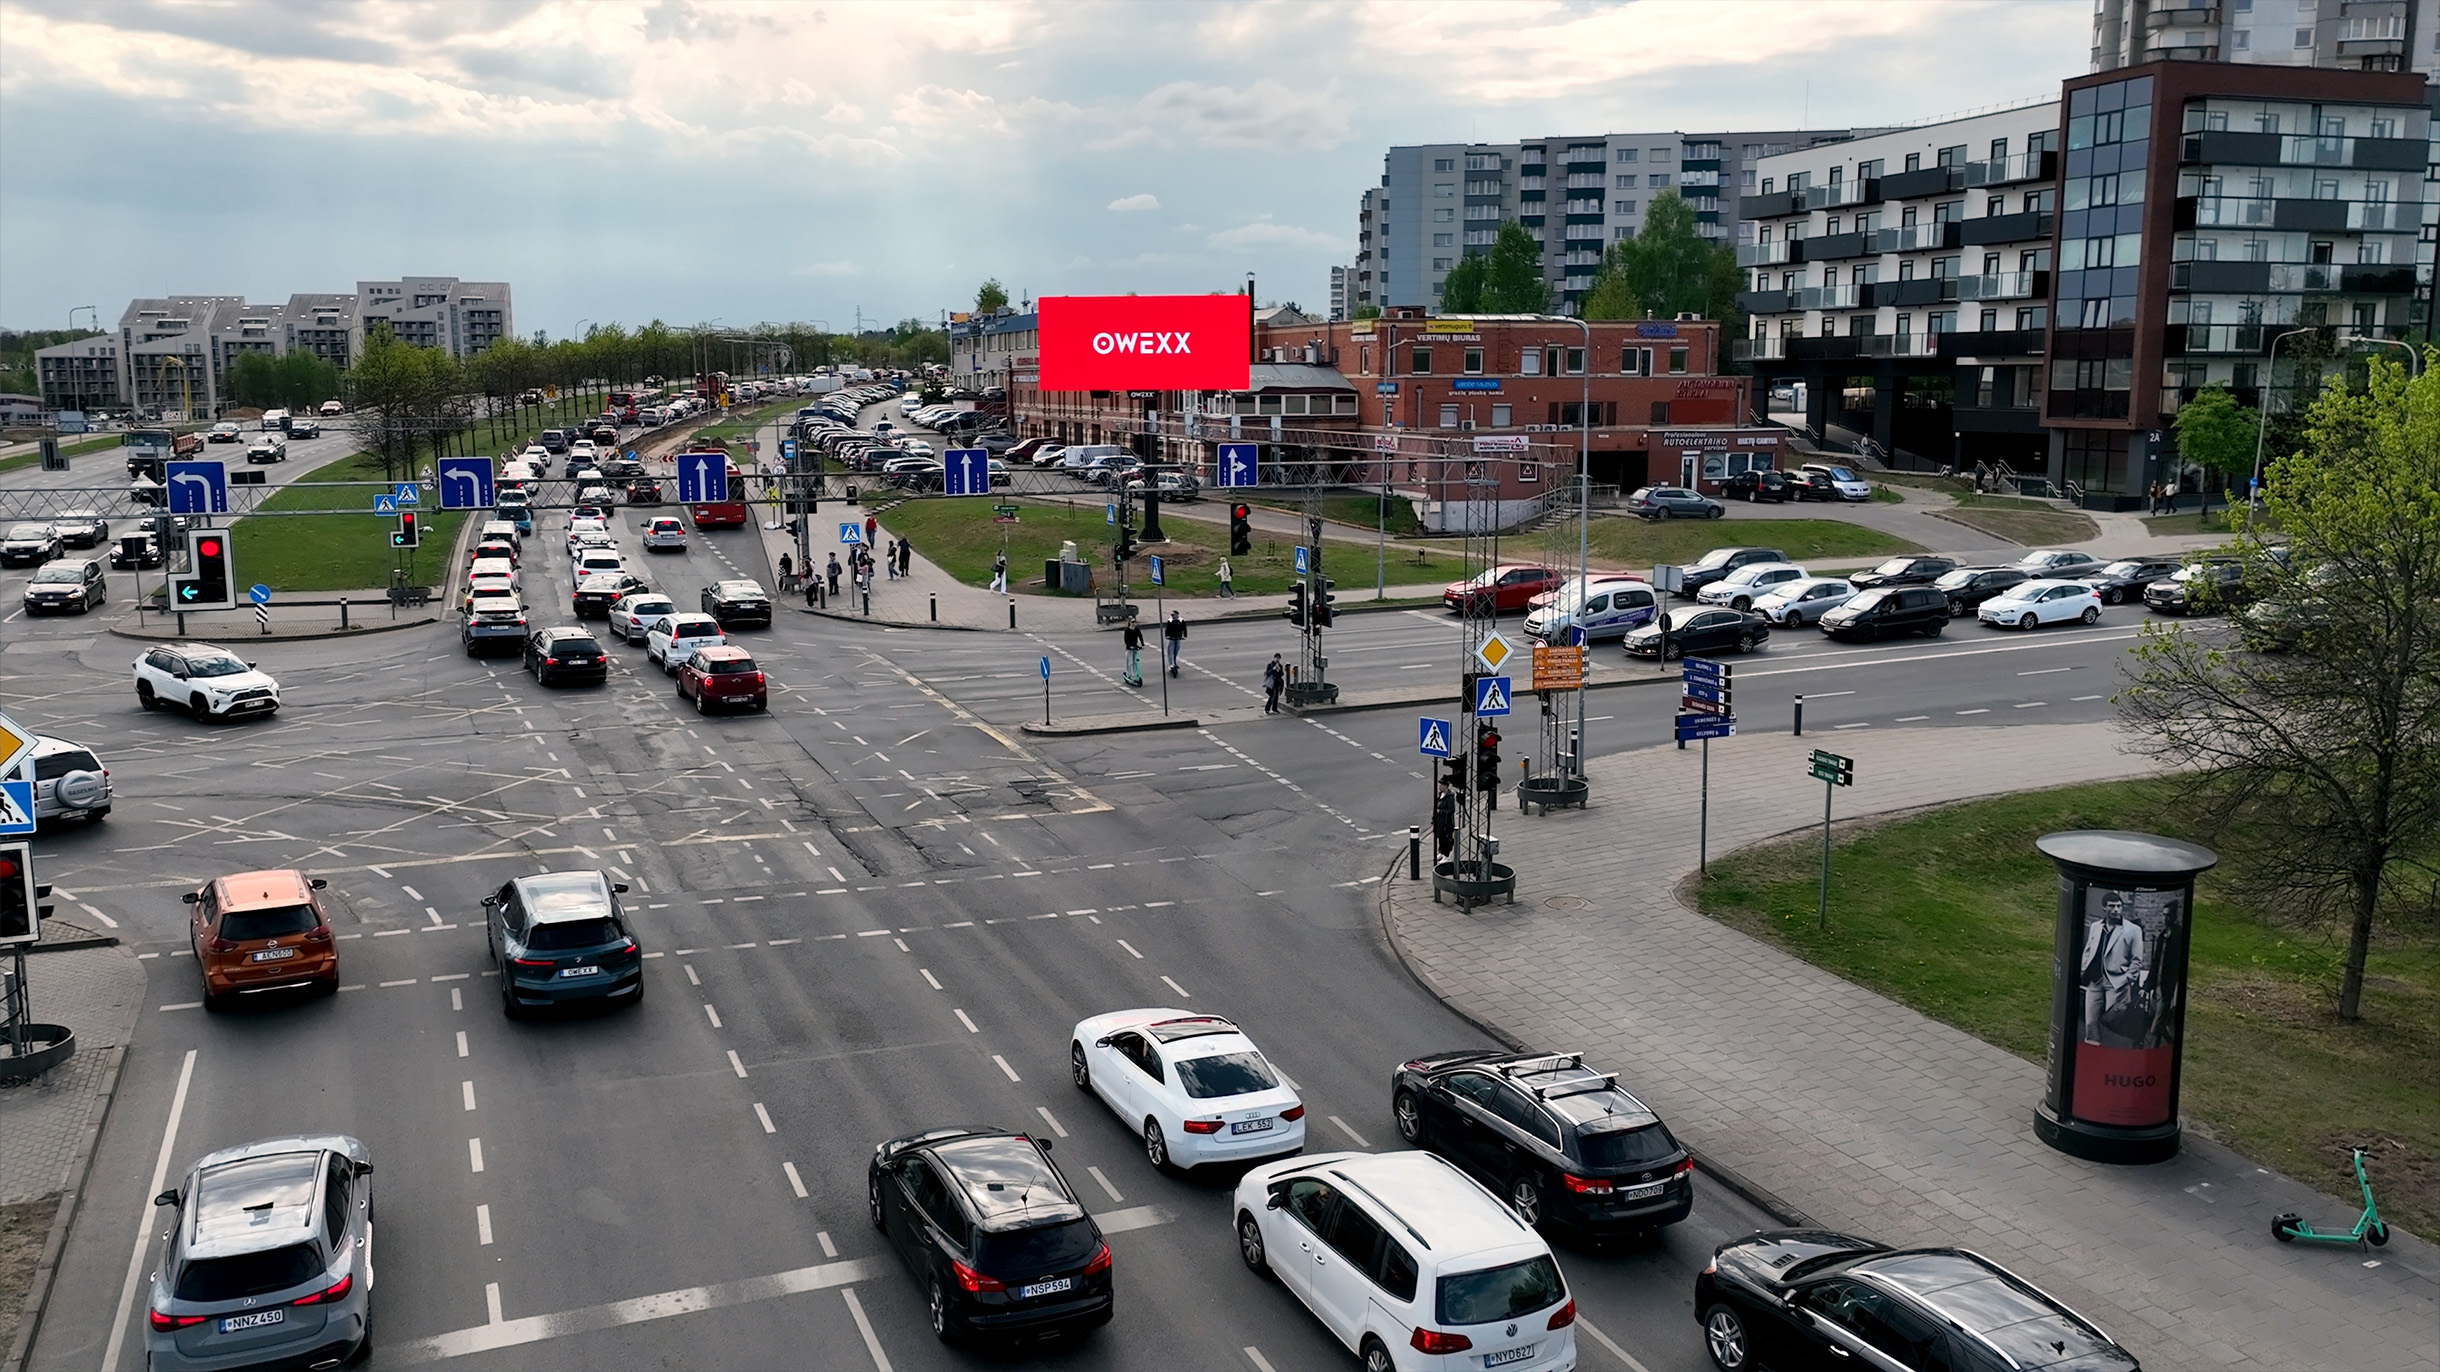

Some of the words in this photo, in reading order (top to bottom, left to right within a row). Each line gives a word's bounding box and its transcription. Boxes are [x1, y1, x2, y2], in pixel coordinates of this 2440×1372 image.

[1092, 332, 1192, 355] OWEXX
[1417, 334, 1451, 342] VERTIMŲ
[1663, 437, 1728, 447] AUTOELEKTRIKO
[2149, 433, 2161, 443] 2A
[67, 786, 98, 796] SUZUKI
[567, 968, 593, 976] OWEXX
[2103, 1073, 2156, 1087] HUGO
[1235, 1121, 1254, 1133] LEK
[1257, 1118, 1272, 1129] 552
[1030, 1284, 1052, 1297] NSP
[1052, 1278, 1070, 1291] 594
[232, 1312, 259, 1329] NNZ
[259, 1309, 282, 1323] 450
